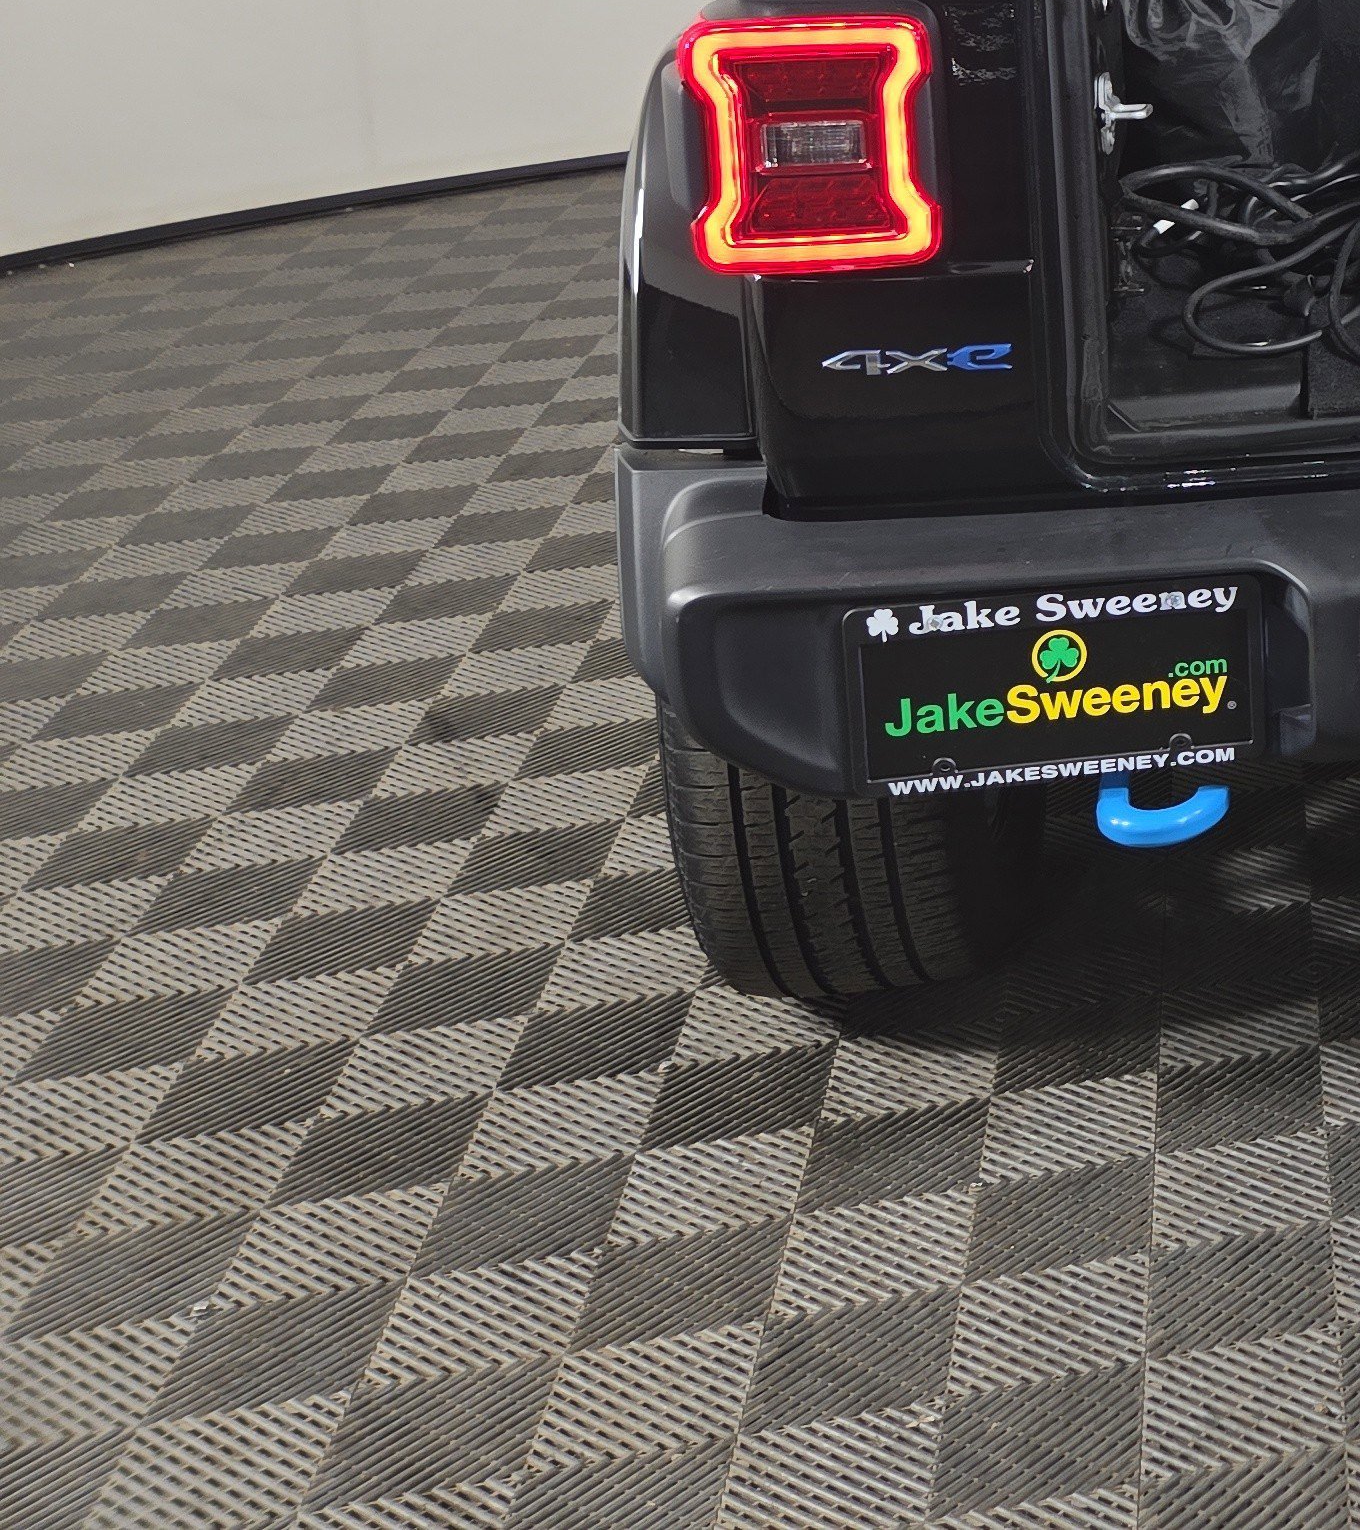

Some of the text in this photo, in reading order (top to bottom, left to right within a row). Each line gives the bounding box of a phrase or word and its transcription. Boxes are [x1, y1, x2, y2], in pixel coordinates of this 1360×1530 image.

[908, 586, 1238, 636] Jake Sweeney
[888, 747, 1235, 796] WWW.JAKESWEENEY.COM
